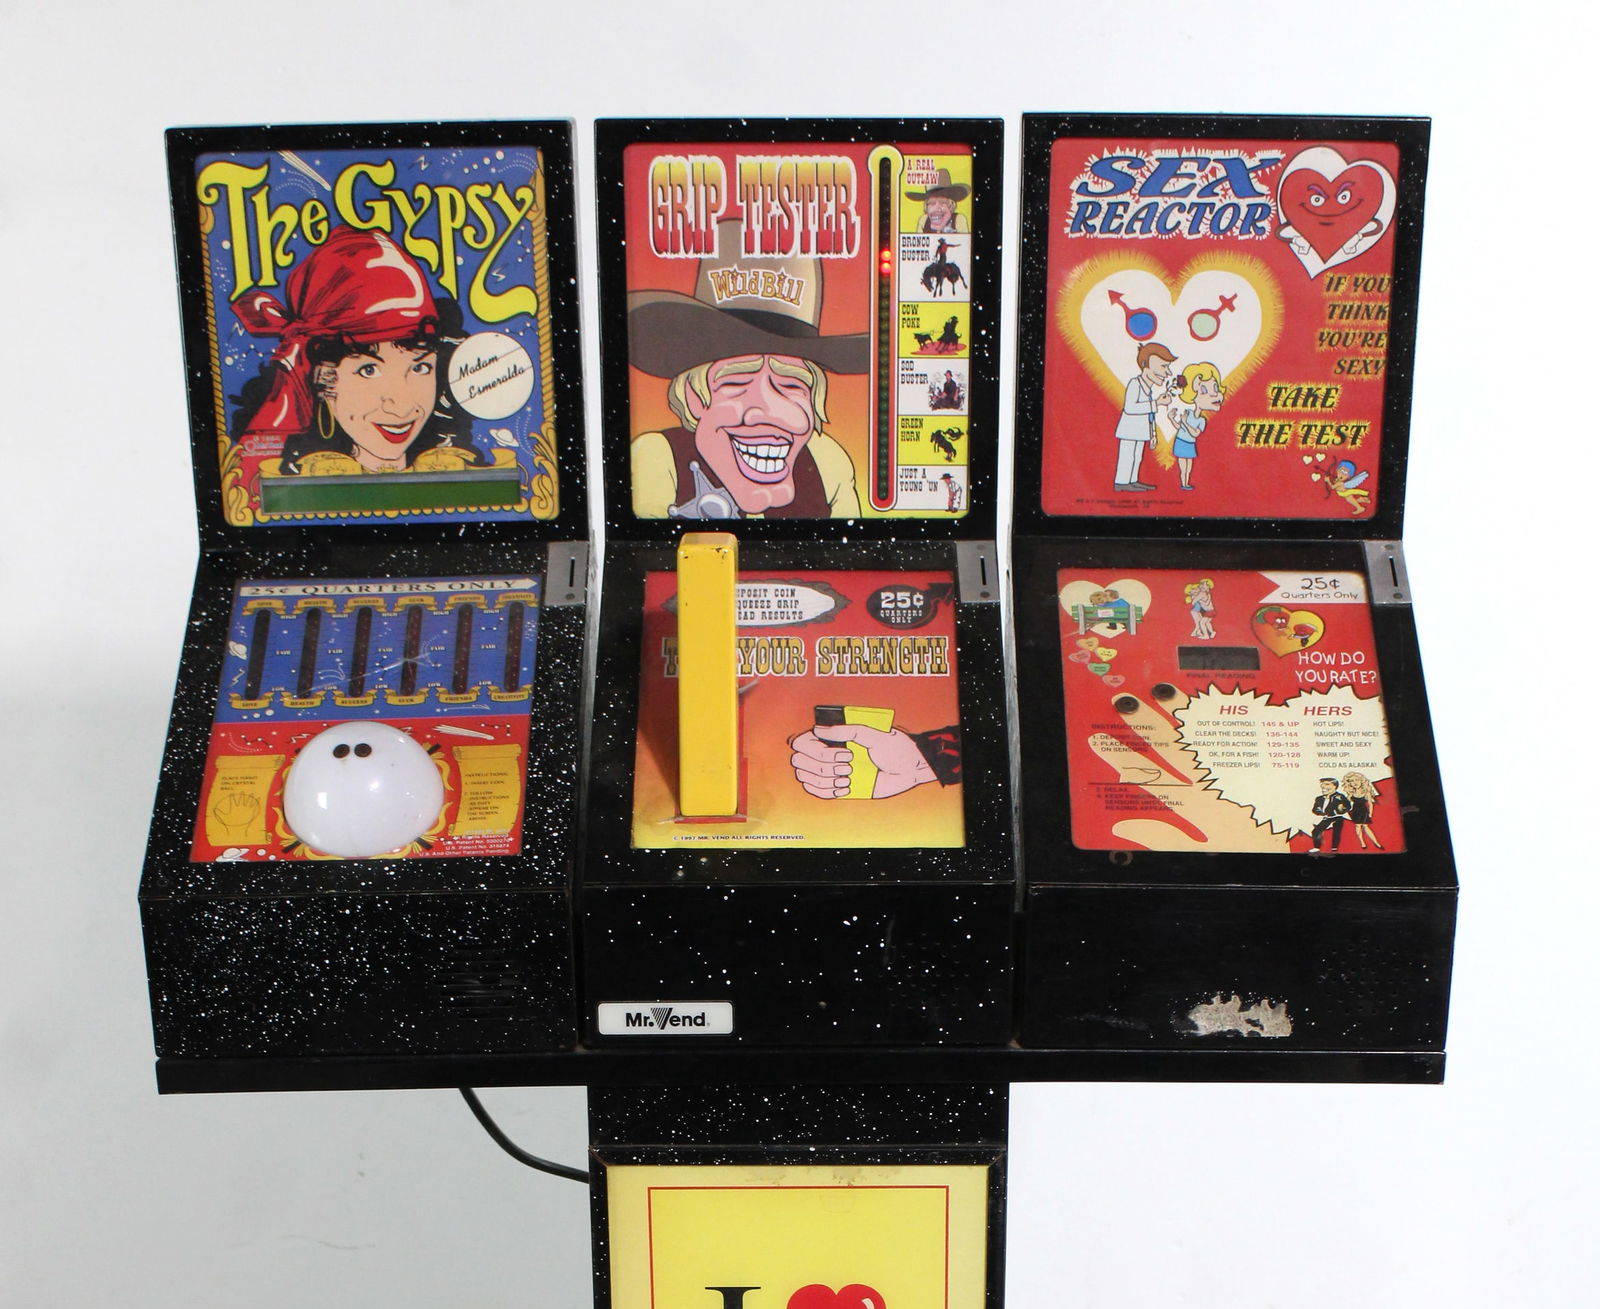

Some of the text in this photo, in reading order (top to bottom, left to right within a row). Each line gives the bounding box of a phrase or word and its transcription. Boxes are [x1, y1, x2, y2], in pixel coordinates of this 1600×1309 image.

[907, 159, 935, 171] A REAL
[907, 173, 939, 185] OUTLAW
[1074, 151, 1285, 198] SEX
[649, 155, 860, 258] GRIP TESTER
[1069, 201, 1273, 237] REACTOR
[197, 158, 537, 322] The Gypsy
[902, 236, 930, 248] BRONCO
[902, 250, 930, 261] BUSTER
[708, 265, 805, 307] Wild Bill
[1325, 276, 1392, 293] IF YOU
[902, 304, 919, 315] COW
[1328, 303, 1389, 320] THINK
[902, 317, 920, 328] POKE
[1319, 331, 1388, 347] YOU'RE
[459, 355, 498, 380] Madam
[901, 360, 914, 371] SOD
[1334, 359, 1385, 375] SEXY
[469, 364, 525, 398] Esmeralda
[901, 374, 928, 384] BUSTER
[1270, 386, 1338, 409] TAKE
[901, 418, 923, 428] GREEN
[901, 431, 920, 441] HORN
[1238, 423, 1368, 446] THE TEST
[900, 468, 927, 478] JUST A
[900, 482, 922, 492] YOUNG
[302, 583, 436, 596] QUARTERS
[448, 581, 515, 590] ONLY
[1301, 577, 1340, 590] 25¢
[737, 588, 796, 598] POSIT COIN
[1334, 591, 1358, 599] Only
[737, 600, 800, 609] QUEEZE GRIP
[880, 592, 924, 609] 25¢
[738, 611, 804, 620] EAD RESULTS
[891, 616, 912, 624] ONLY
[738, 636, 950, 677] YOUR STRENGTH
[1298, 651, 1365, 665] HOW DO
[1295, 669, 1377, 684] YOU RATE?
[1220, 705, 1248, 715] HIS
[1304, 706, 1352, 716] HERS
[626, 1007, 706, 1030] Mr. Vend
